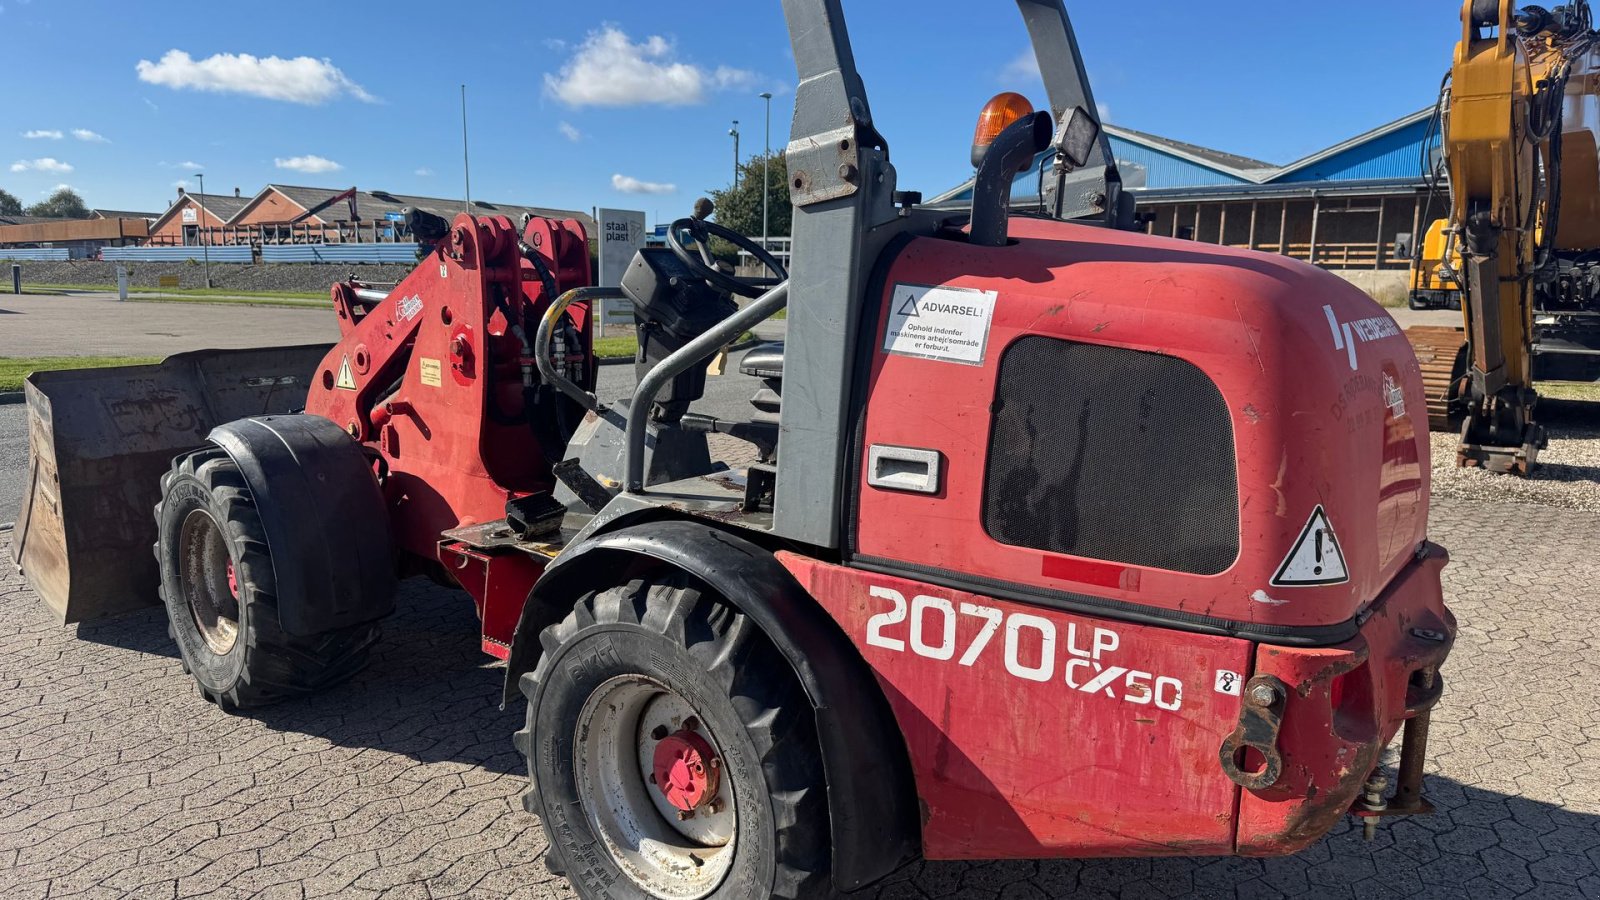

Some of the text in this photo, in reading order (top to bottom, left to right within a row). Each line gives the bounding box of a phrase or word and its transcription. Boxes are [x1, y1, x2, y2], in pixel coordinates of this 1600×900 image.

[606, 221, 628, 231] staal
[606, 232, 629, 243] plast
[922, 302, 983, 317] ADVARSEL!
[890, 330, 926, 341] maskinens
[908, 323, 963, 336] Ophold indenfor
[866, 585, 1120, 683] 2070 LP
[1064, 658, 1183, 711] CX50
